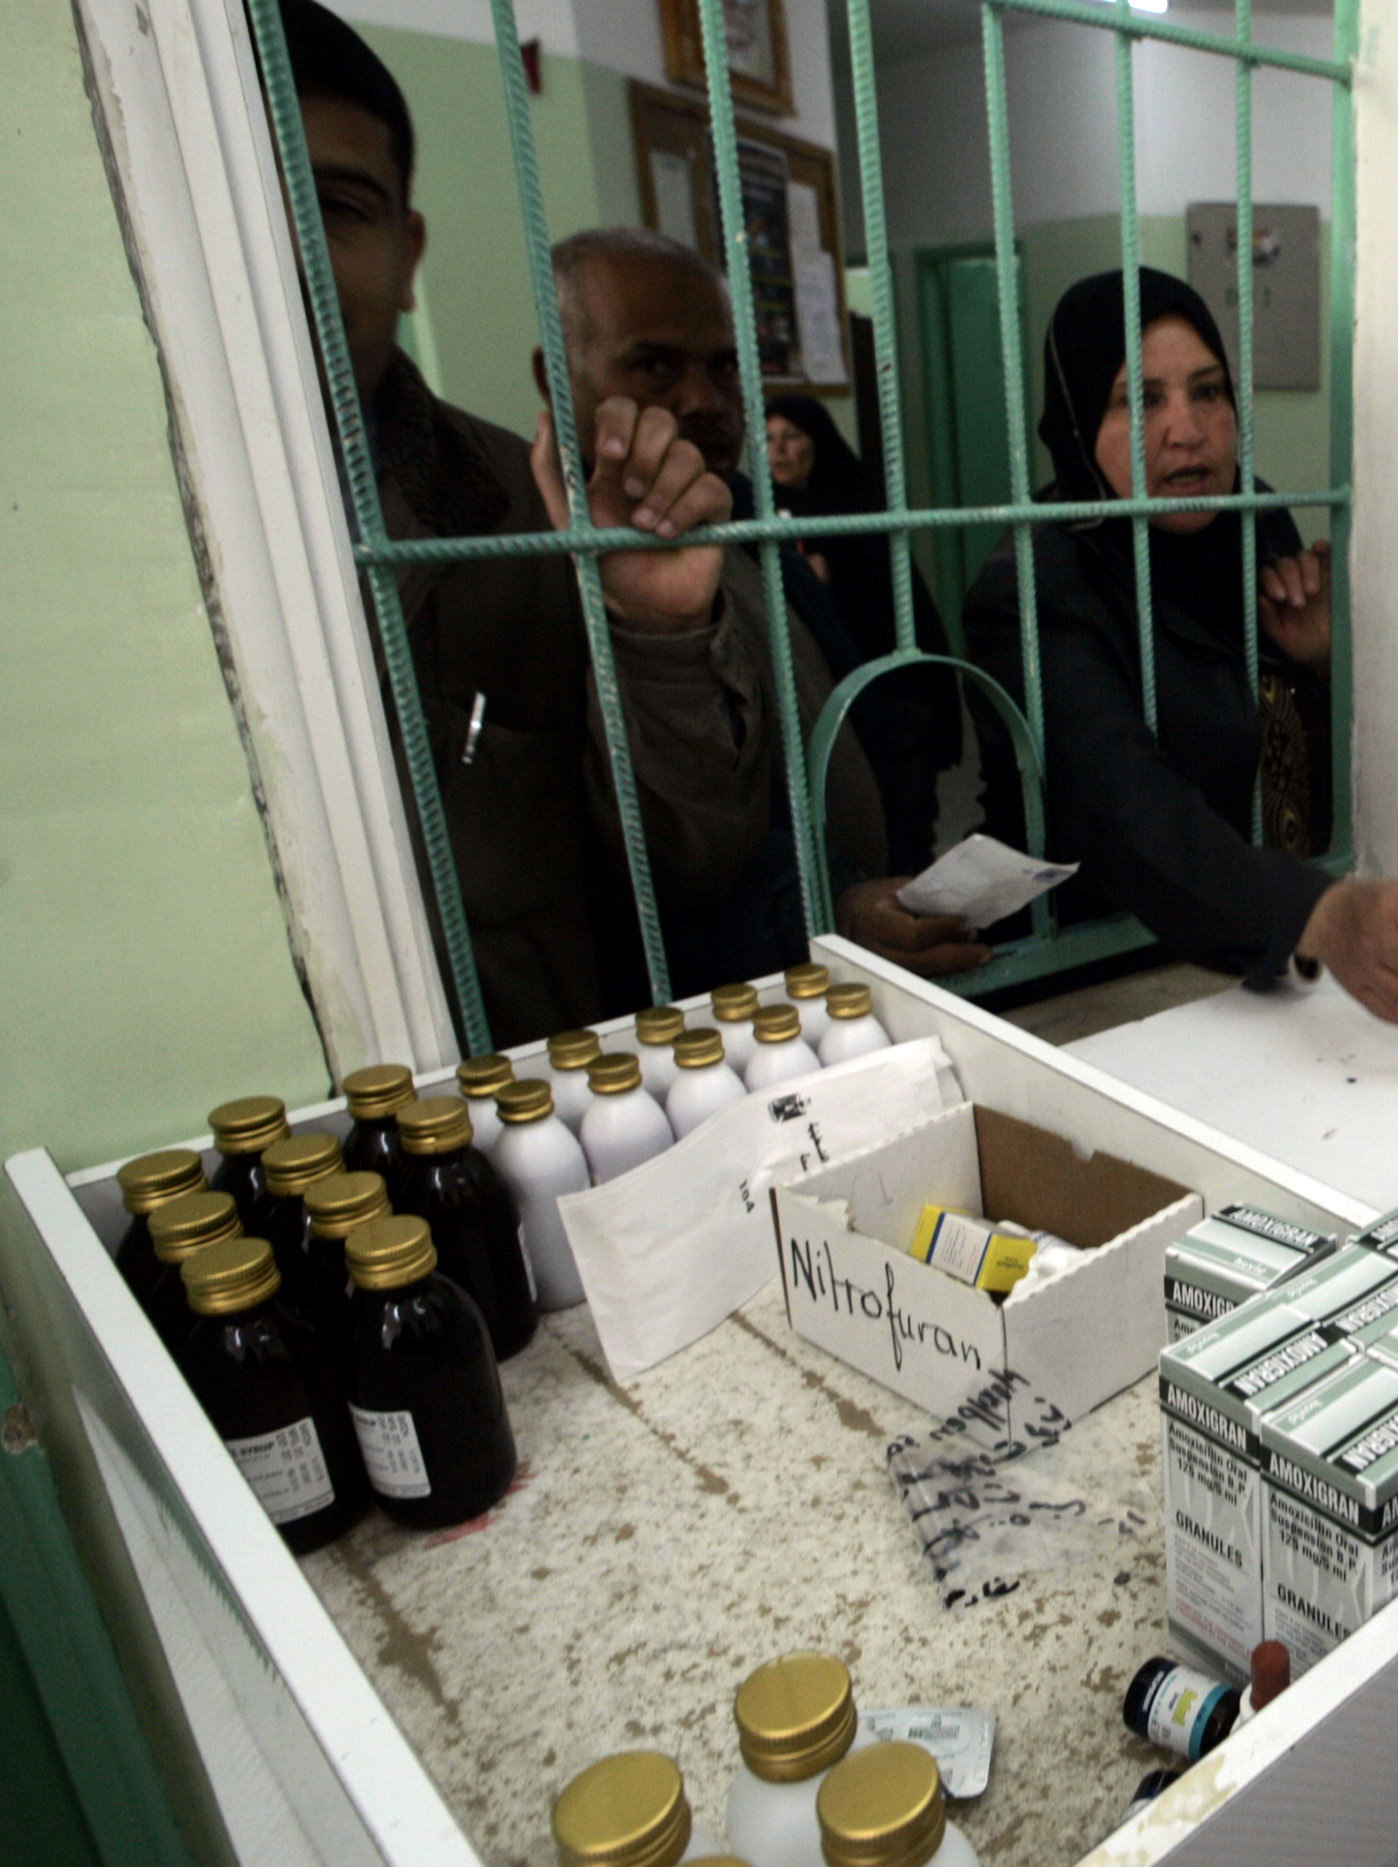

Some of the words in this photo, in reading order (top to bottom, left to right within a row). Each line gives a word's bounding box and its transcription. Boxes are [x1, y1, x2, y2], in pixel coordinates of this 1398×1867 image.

[790, 1237, 982, 1373] Nitrofuran
[1233, 1331, 1328, 1395] AMOXIGRAN
[1167, 1383, 1247, 1450] AMOXIGRAN
[1169, 1422, 1224, 1466] Amoxicillin
[1226, 1460, 1248, 1482] Oral
[1269, 1450, 1360, 1525] AMOXIGRAN
[1176, 1509, 1243, 1569] GRANULES
[1270, 1492, 1332, 1540] Amoxicillin
[1335, 1533, 1359, 1558] Oral
